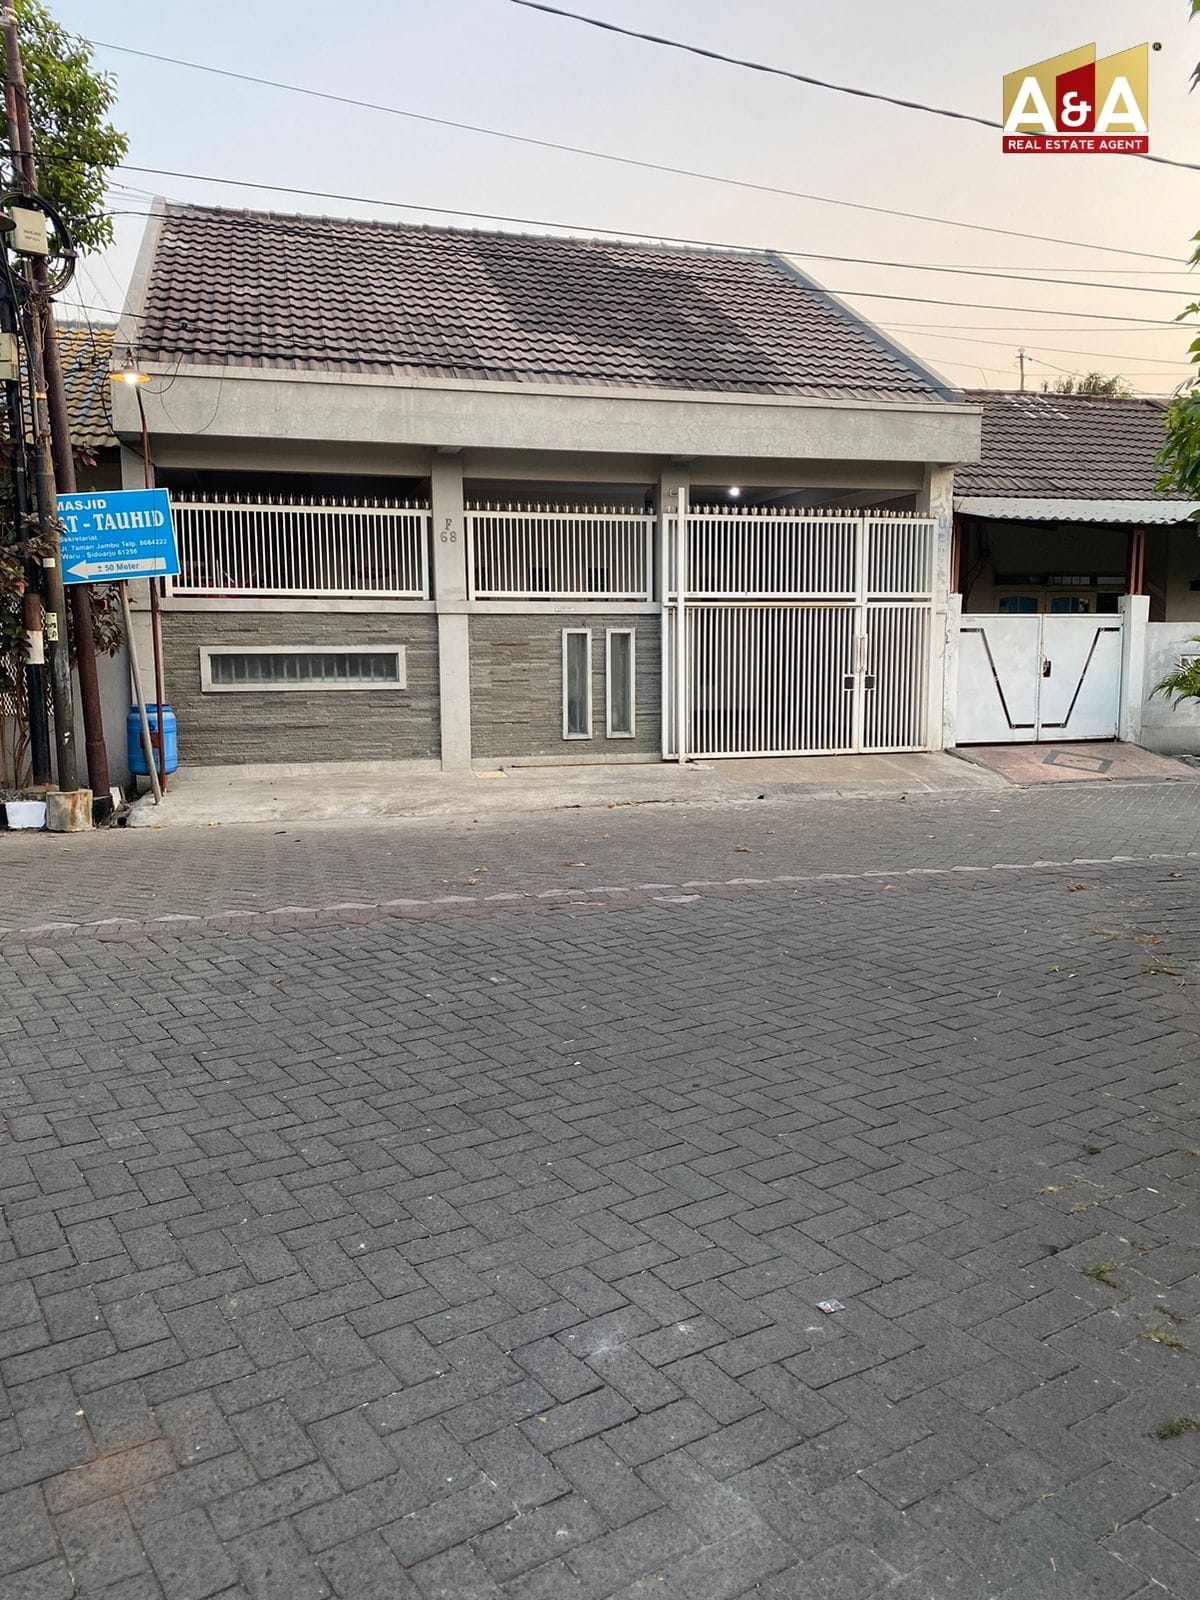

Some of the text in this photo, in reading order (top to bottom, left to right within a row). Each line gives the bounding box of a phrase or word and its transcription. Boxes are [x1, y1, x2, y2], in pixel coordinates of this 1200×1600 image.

[56, 498, 107, 512] MASJID
[93, 509, 165, 531] TAUHID
[445, 517, 452, 531] F
[440, 530, 457, 543] 68
[86, 551, 117, 559] Sidoarjo
[104, 563, 114, 572] 50
[116, 562, 140, 571] Meter
